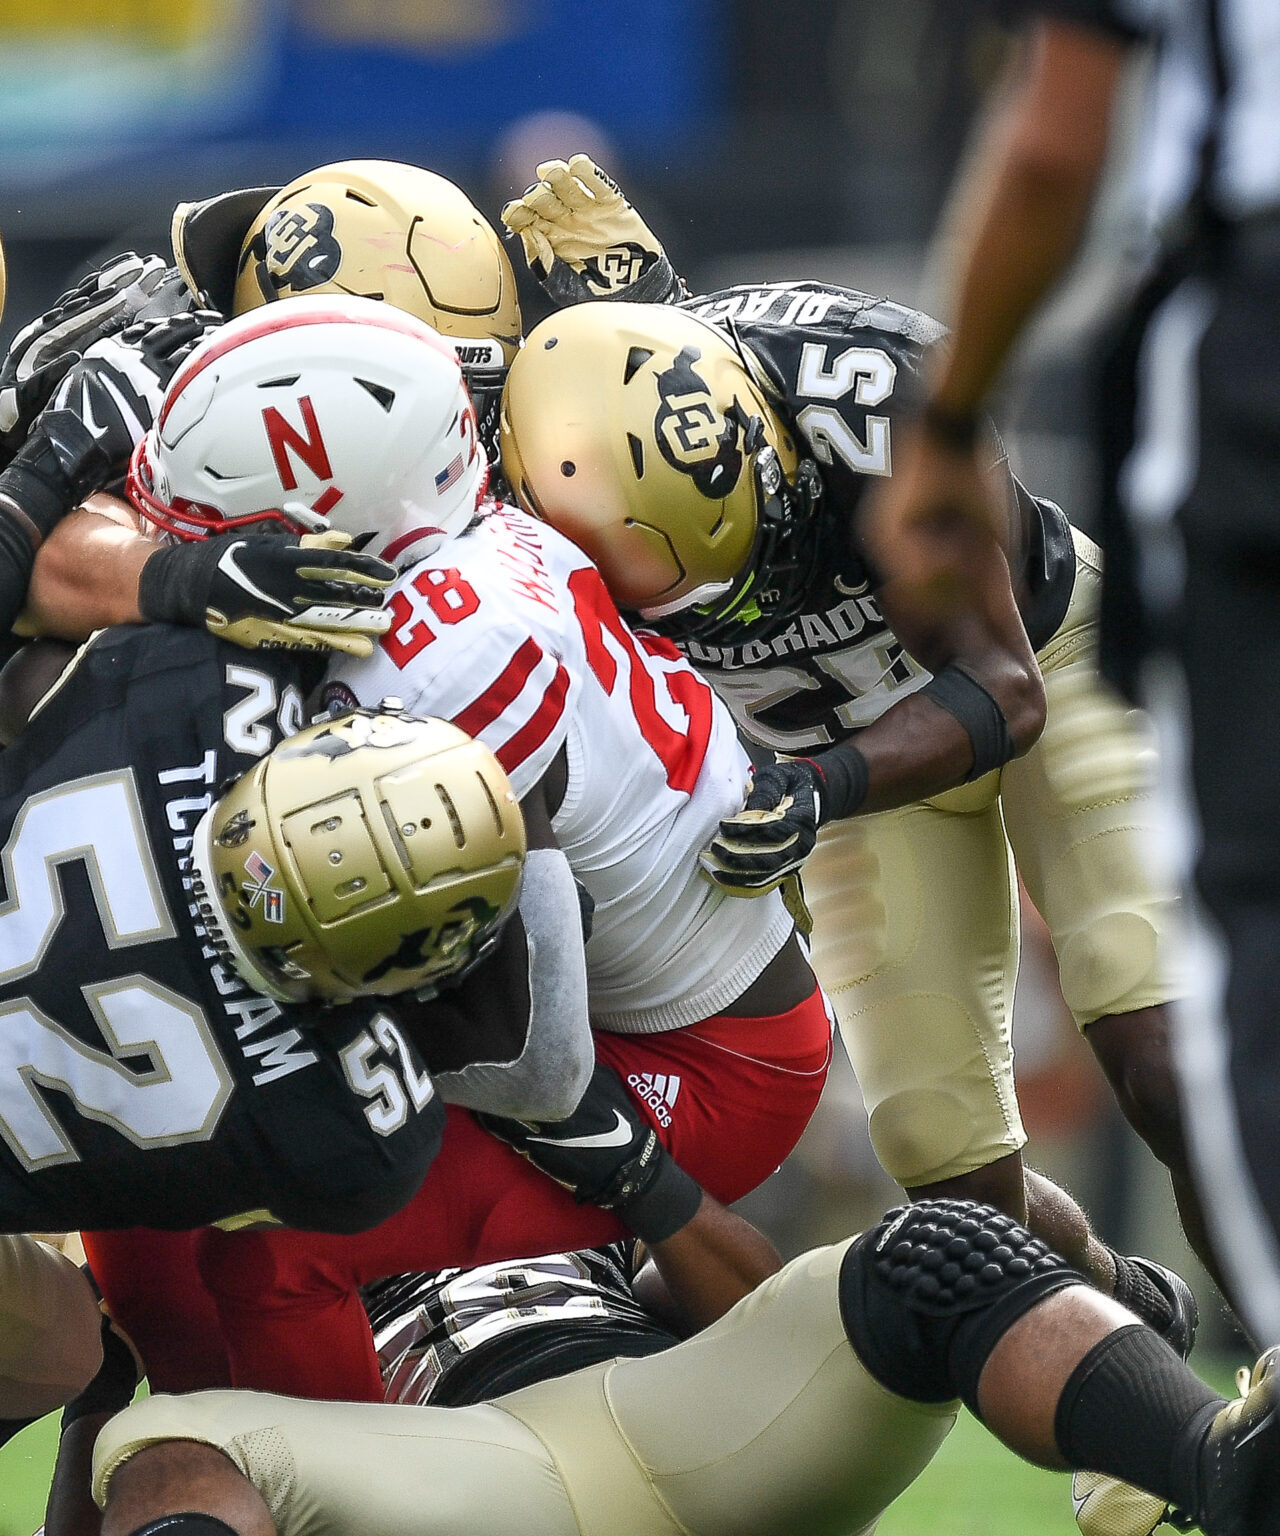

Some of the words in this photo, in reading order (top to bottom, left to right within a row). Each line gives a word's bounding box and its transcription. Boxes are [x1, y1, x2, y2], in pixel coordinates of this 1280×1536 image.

[261, 394, 334, 491] N
[795, 341, 898, 477] 25
[380, 567, 481, 671] 28
[567, 567, 713, 793] 2
[338, 1012, 435, 1138] 52
[627, 1074, 673, 1128] adidas
